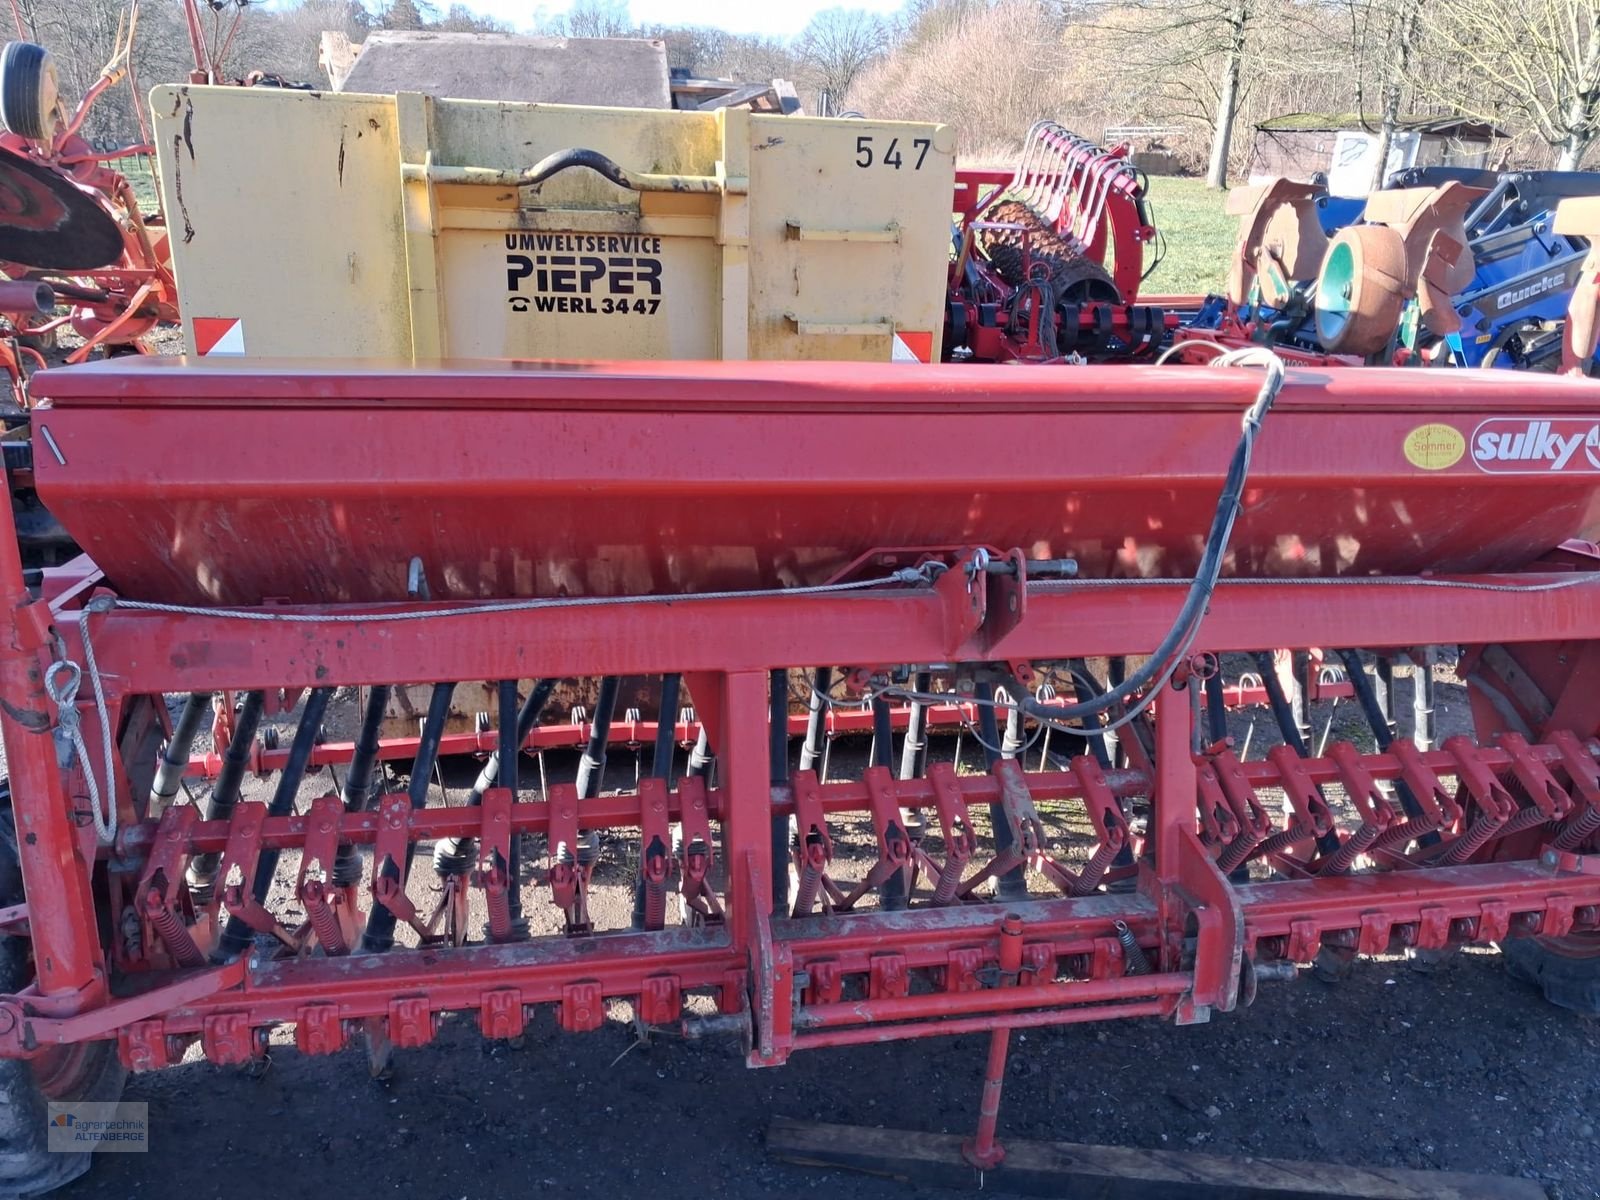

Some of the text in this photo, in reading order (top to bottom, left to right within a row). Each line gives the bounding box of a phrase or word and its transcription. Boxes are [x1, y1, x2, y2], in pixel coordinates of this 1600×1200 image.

[856, 136, 931, 170] 547
[505, 233, 661, 254] UMWELTSERVICE
[534, 296, 597, 313] WERL
[1413, 441, 1457, 452] Sommer
[1474, 421, 1586, 470] sulky
